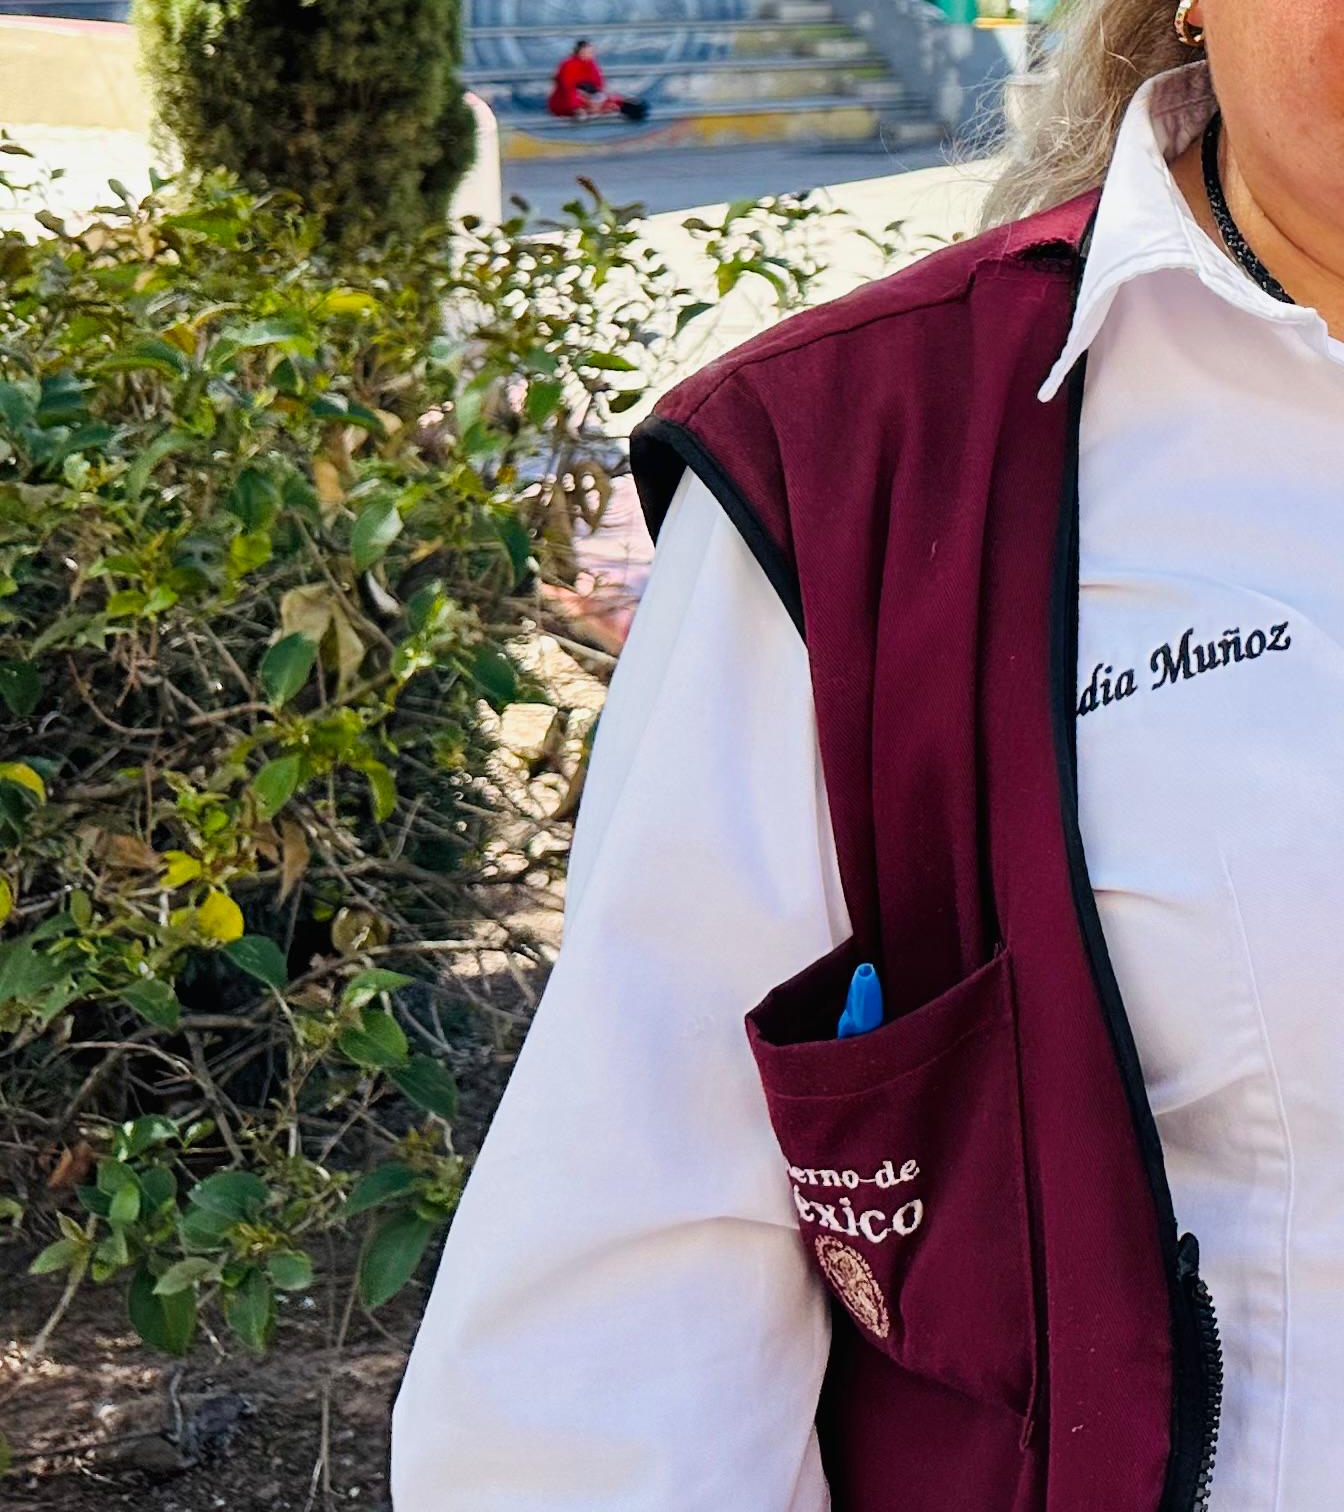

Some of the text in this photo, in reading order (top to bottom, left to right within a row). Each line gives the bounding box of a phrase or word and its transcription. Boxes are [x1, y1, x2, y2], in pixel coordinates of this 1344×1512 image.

[1077, 621, 1291, 717] dia Muñoz
[789, 1159, 921, 1189] erno de
